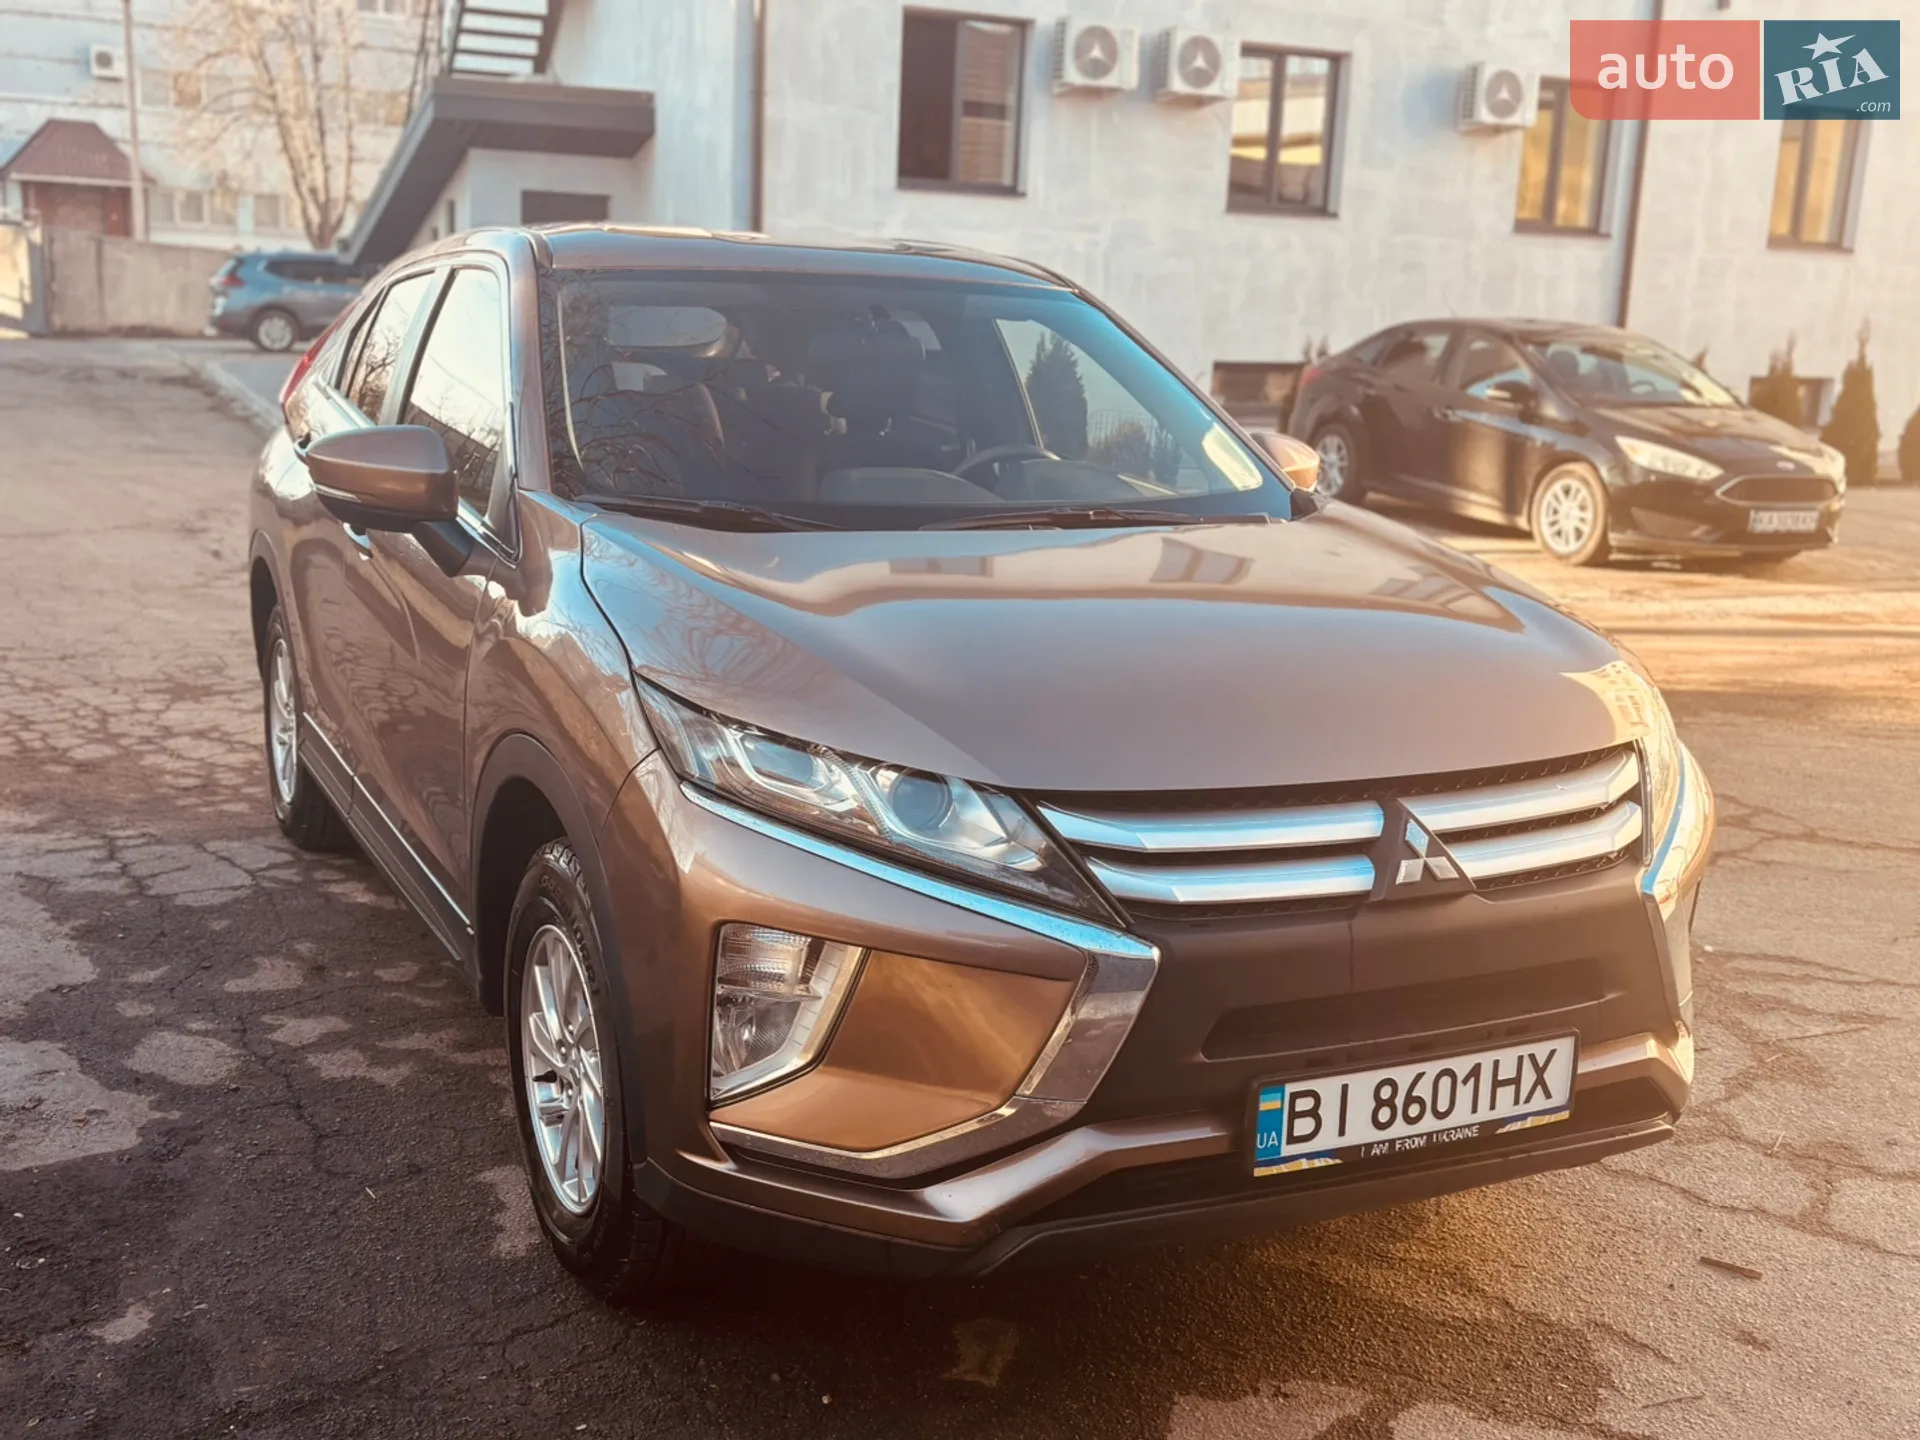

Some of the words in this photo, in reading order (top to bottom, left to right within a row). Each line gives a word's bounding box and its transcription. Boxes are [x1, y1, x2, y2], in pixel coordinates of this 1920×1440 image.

[1286, 1083, 1349, 1146] BI
[1371, 1048, 1558, 1131] 8601HX
[1256, 1131, 1279, 1149] UA
[1361, 1145, 1366, 1157] I
[1371, 1142, 1390, 1156] AM
[1395, 1135, 1427, 1152] FROM
[1433, 1124, 1480, 1143] UKRAINE
